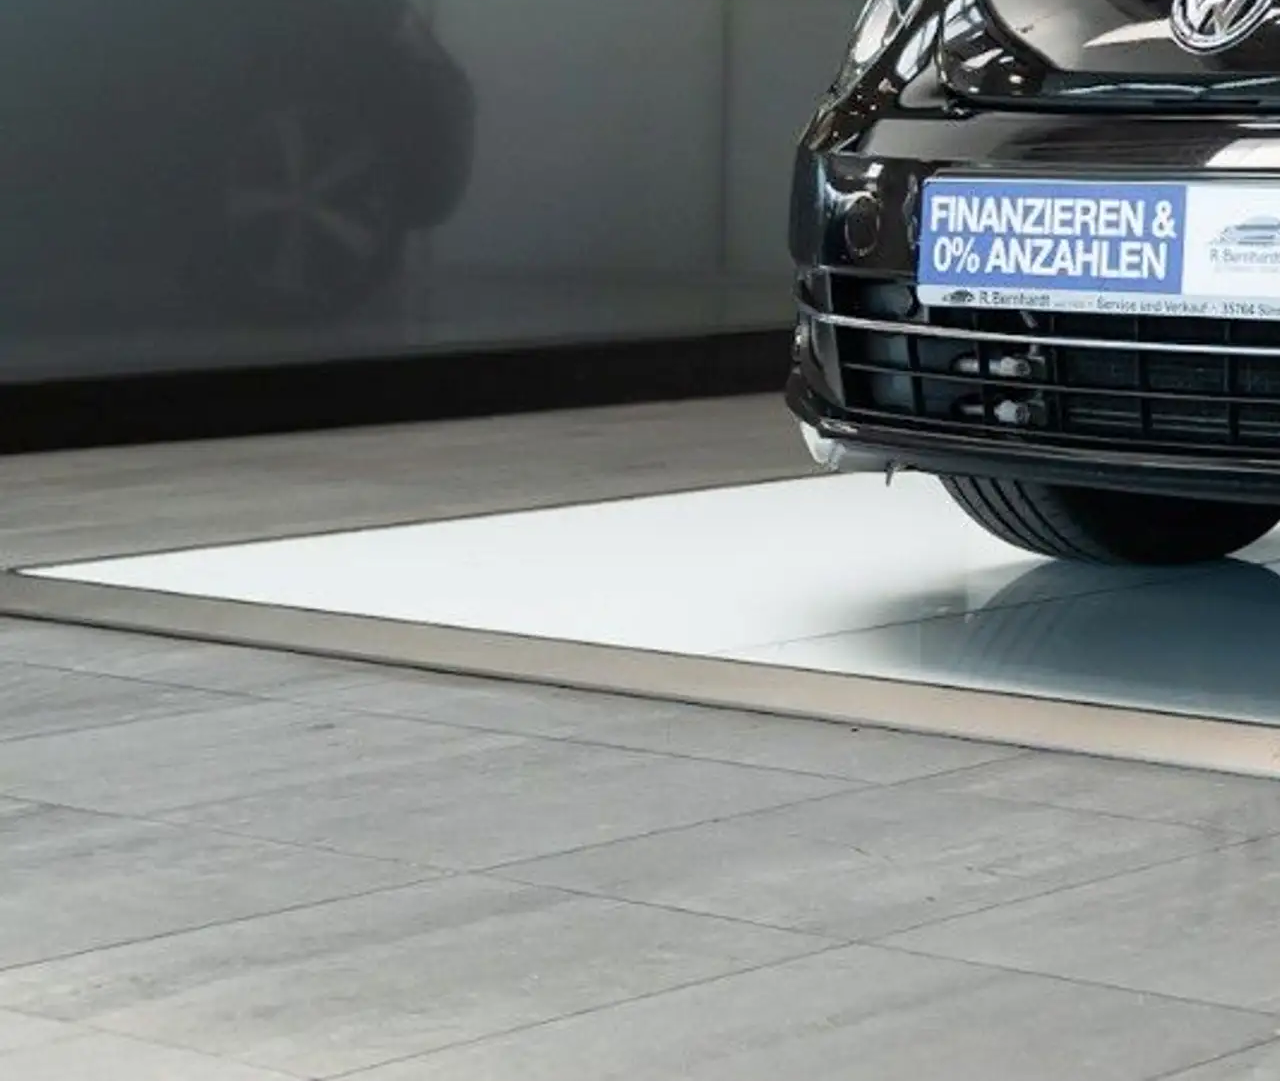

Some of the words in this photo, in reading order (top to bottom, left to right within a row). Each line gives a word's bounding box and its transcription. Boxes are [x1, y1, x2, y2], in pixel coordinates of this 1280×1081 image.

[930, 195, 1145, 237] FINANZIEREN
[1152, 200, 1178, 239] &
[933, 237, 980, 273] 0%
[986, 237, 1168, 279] ANZAHLEN
